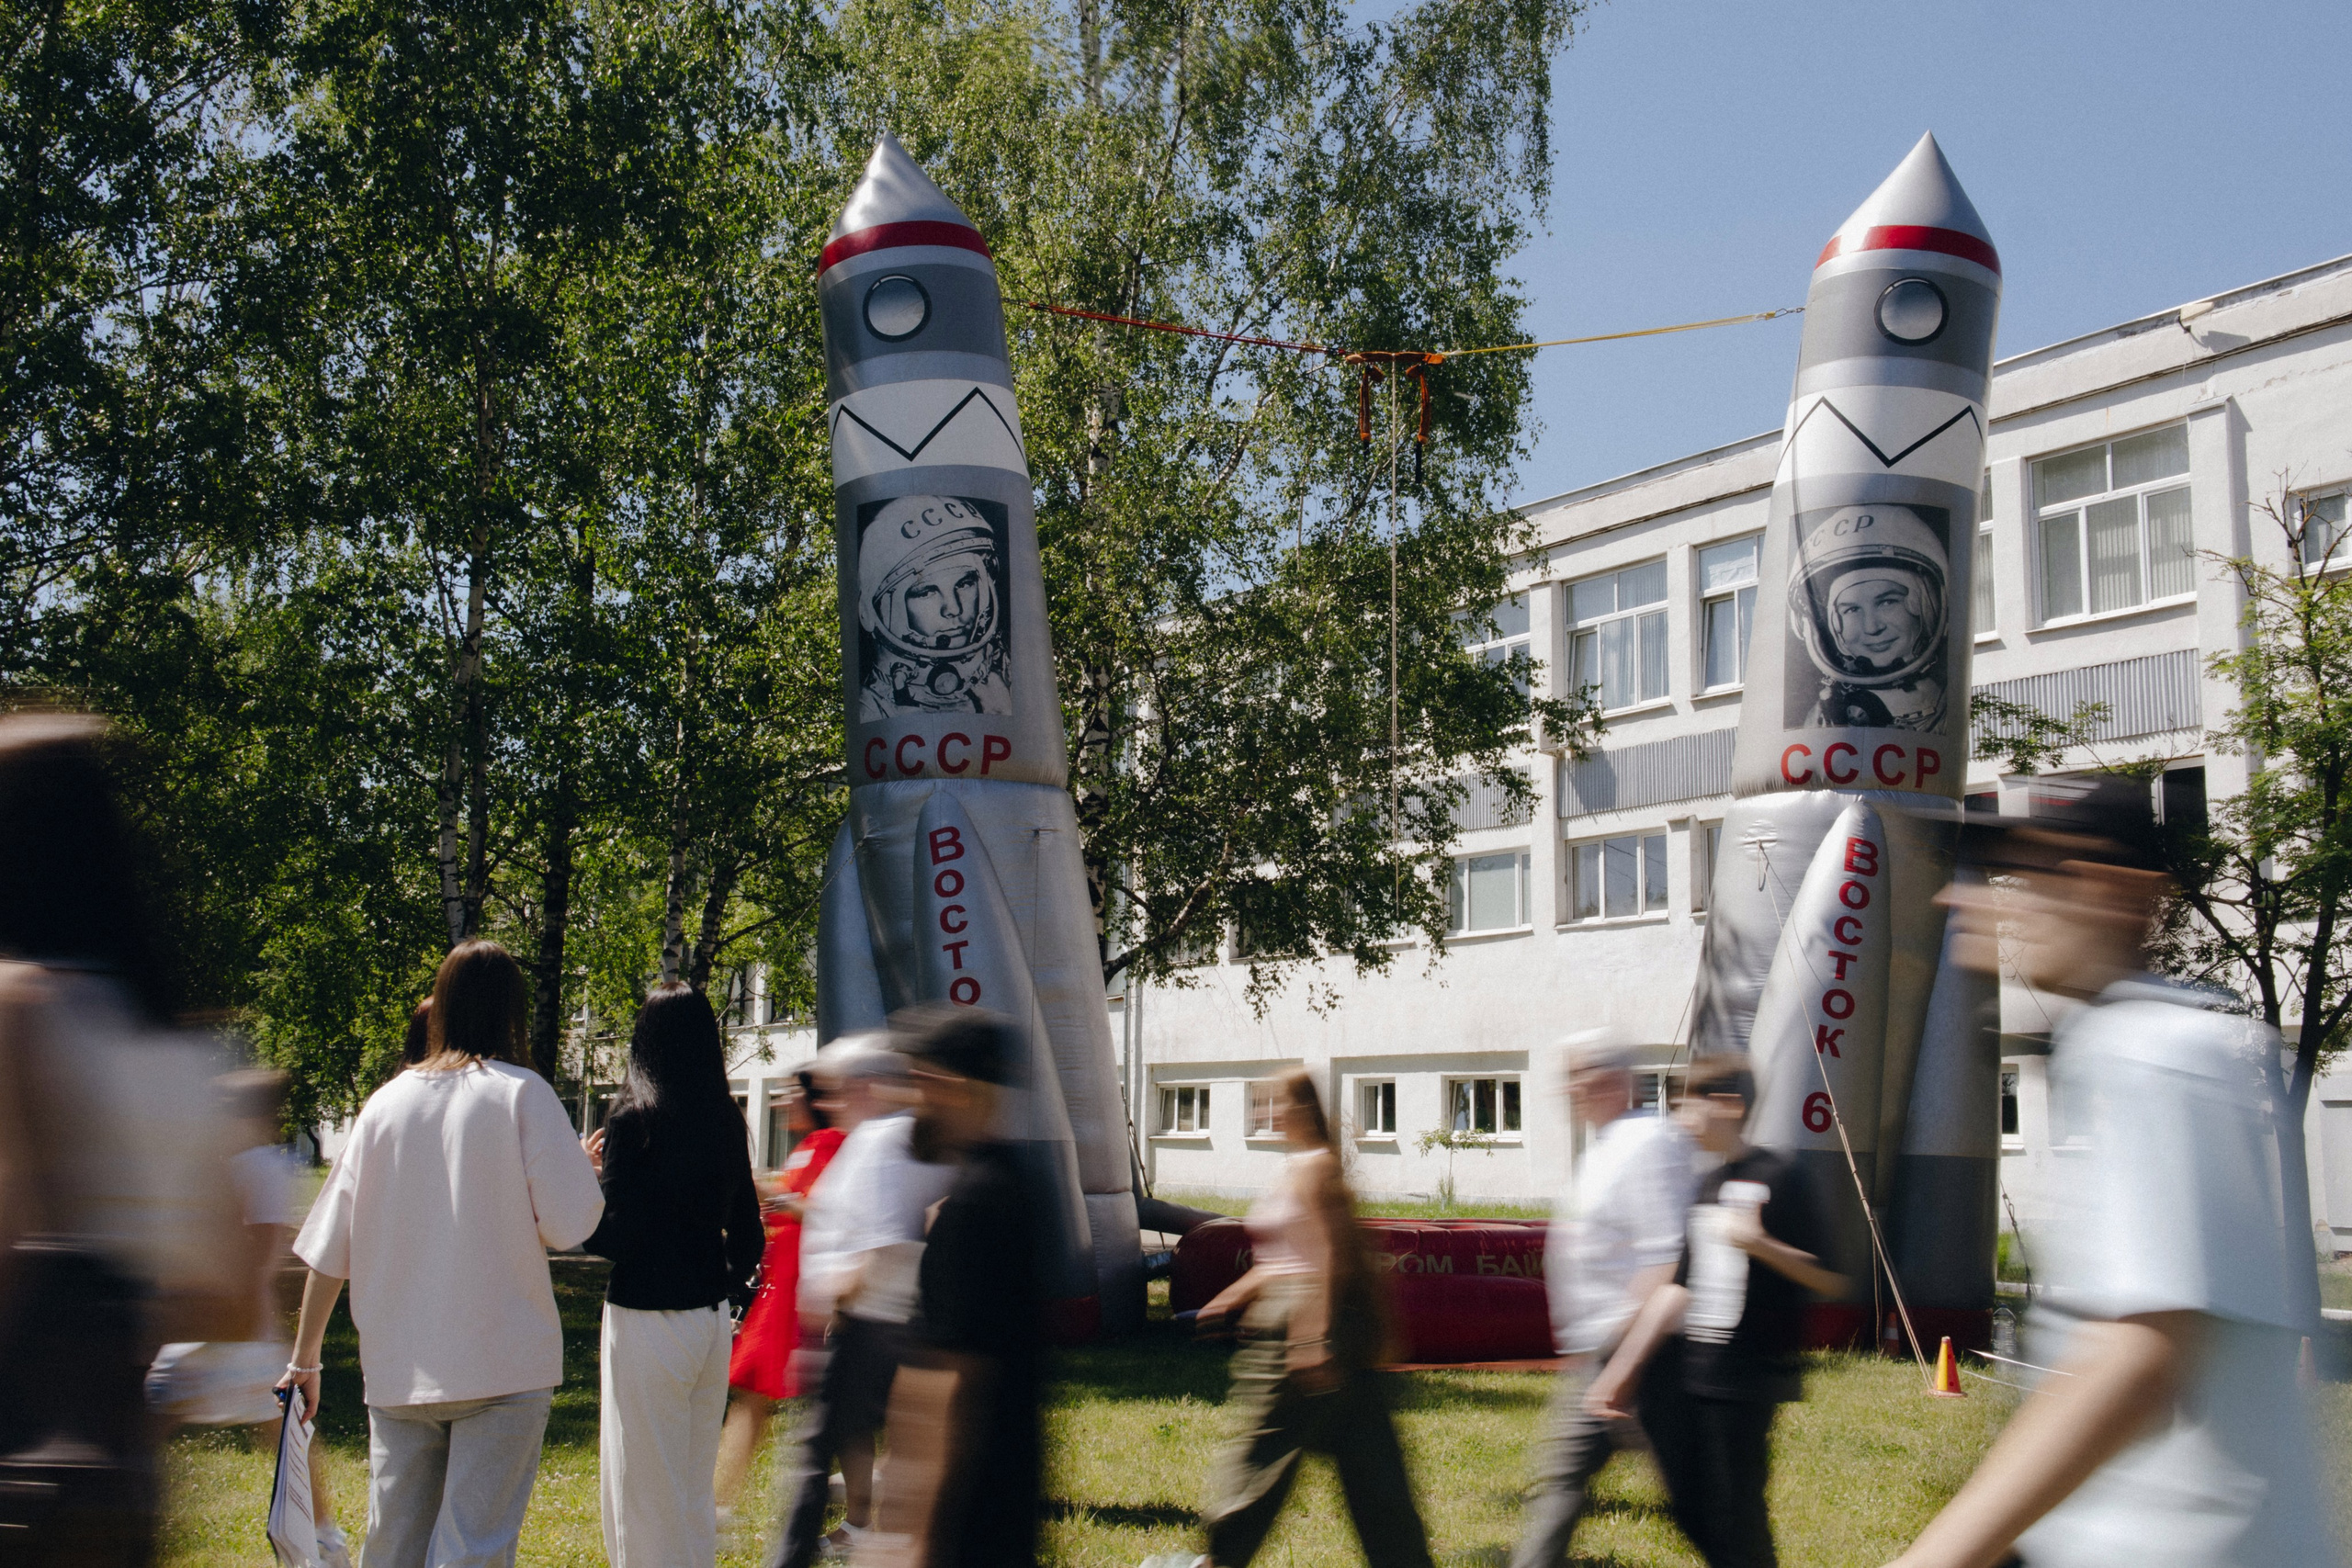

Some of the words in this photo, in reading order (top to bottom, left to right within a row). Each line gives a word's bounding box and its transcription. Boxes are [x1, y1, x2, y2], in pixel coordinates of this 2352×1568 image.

[900, 501, 982, 539] СССР
[864, 732, 1012, 779] СССР
[1781, 742, 1940, 788] СССР
[1802, 1091, 1833, 1134] 6
[1476, 1247, 1548, 1277] БАЙ
